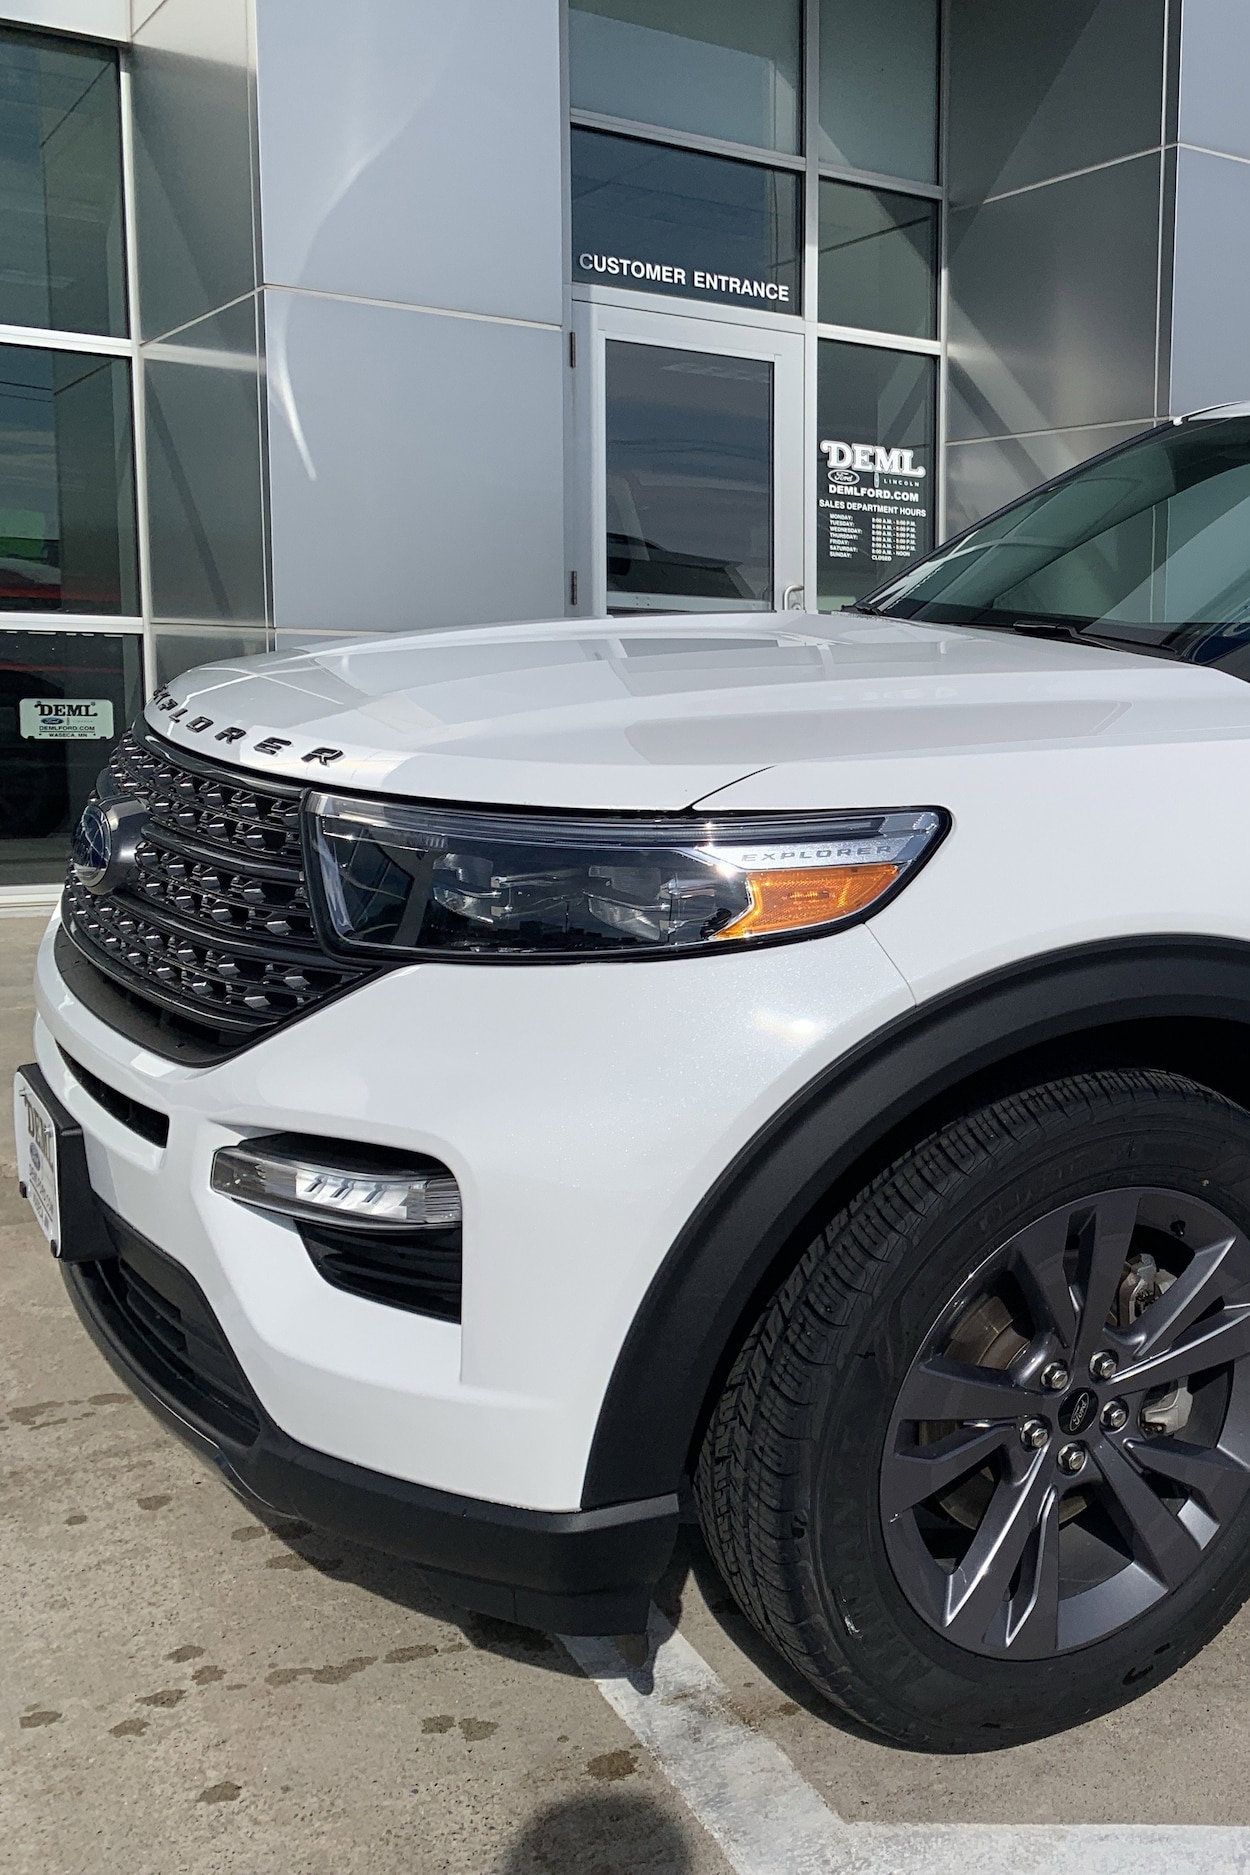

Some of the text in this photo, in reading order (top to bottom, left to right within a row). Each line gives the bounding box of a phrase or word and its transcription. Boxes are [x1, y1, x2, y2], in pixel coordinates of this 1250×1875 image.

[579, 253, 790, 302] CUSTOMER ENTRANCE
[820, 440, 926, 478] DEML
[884, 478, 920, 487] LINCOLN
[829, 484, 919, 502] DEMLFORD.COM
[819, 499, 927, 517] SALES DEPARTMENT HOURS
[34, 703, 98, 717] DEML
[741, 845, 891, 861] EXPLORER
